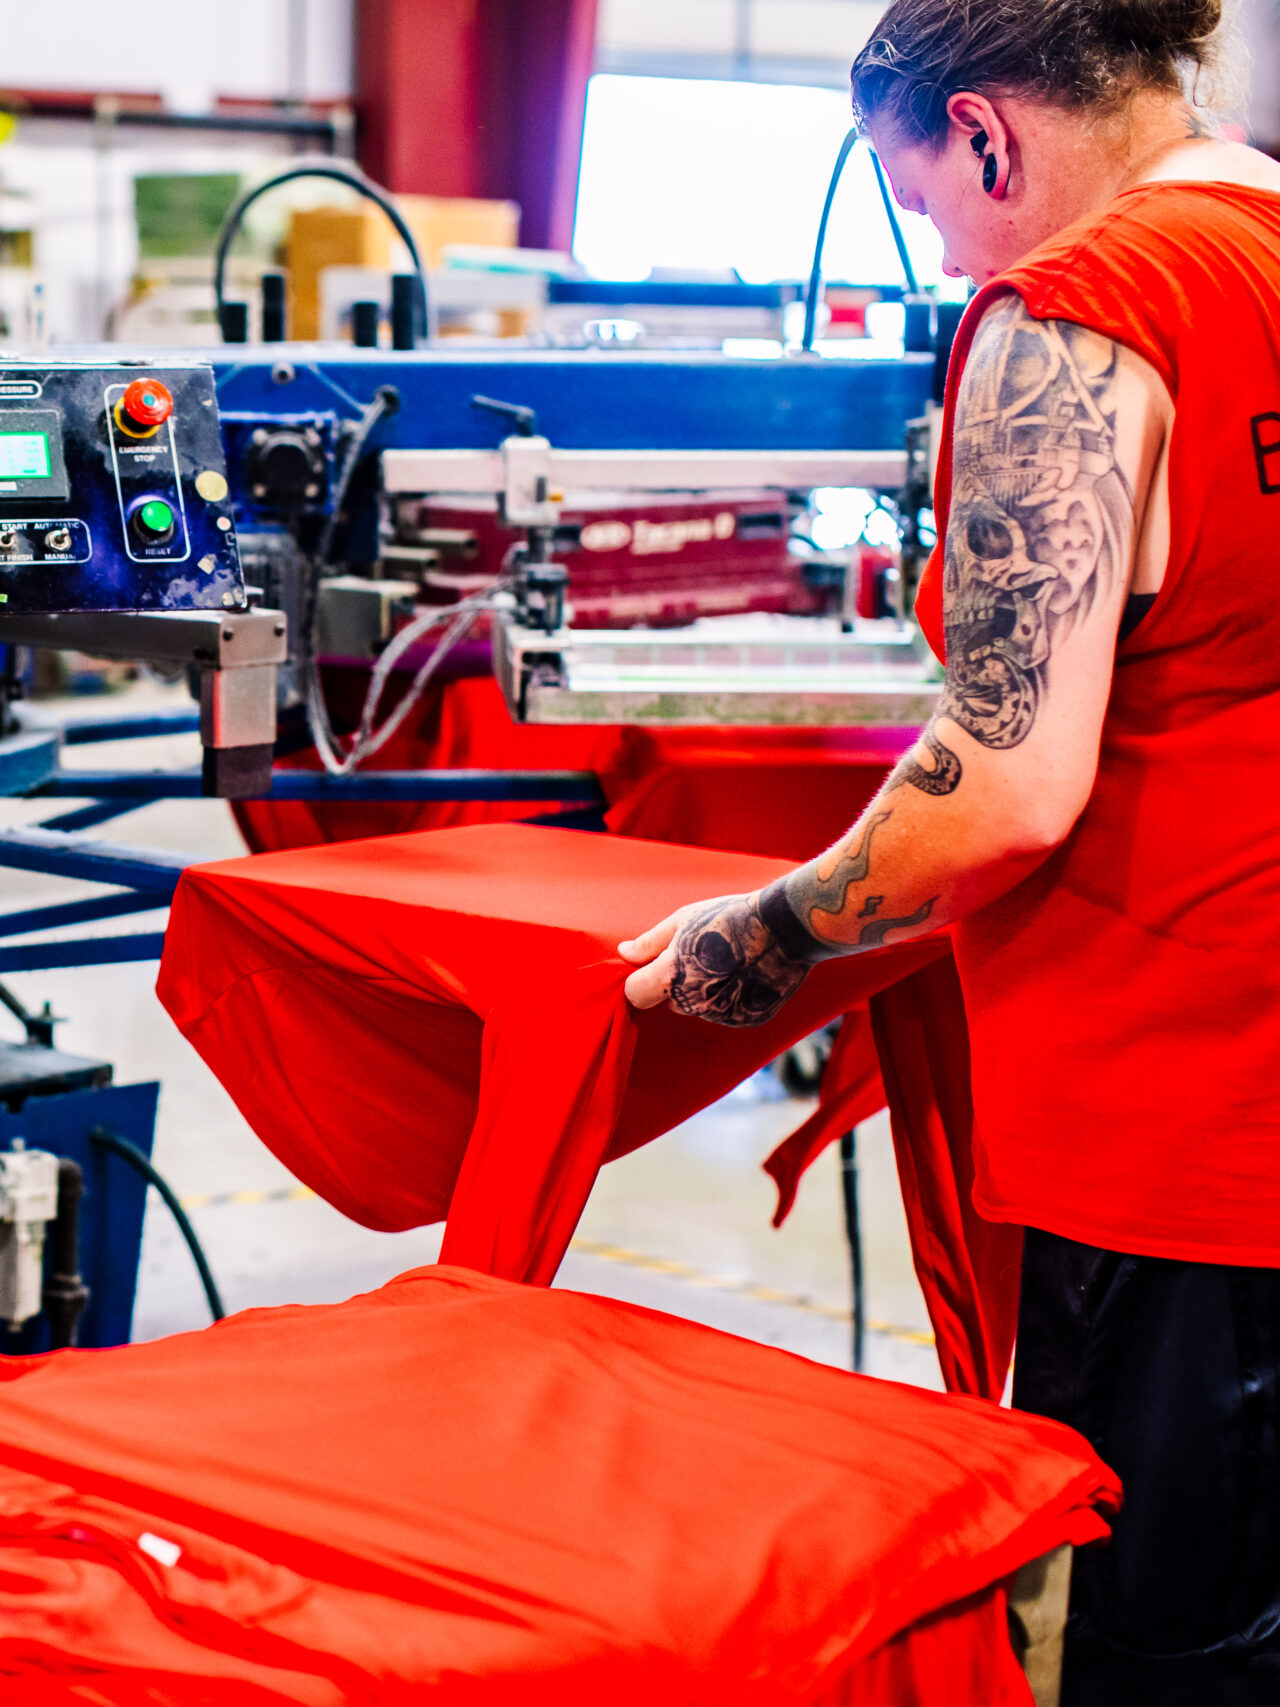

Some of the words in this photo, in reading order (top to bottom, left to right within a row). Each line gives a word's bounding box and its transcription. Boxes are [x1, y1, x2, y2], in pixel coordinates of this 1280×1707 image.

[133, 454, 156, 462] STOP
[1, 523, 28, 531] START
[145, 547, 171, 555] RESET
